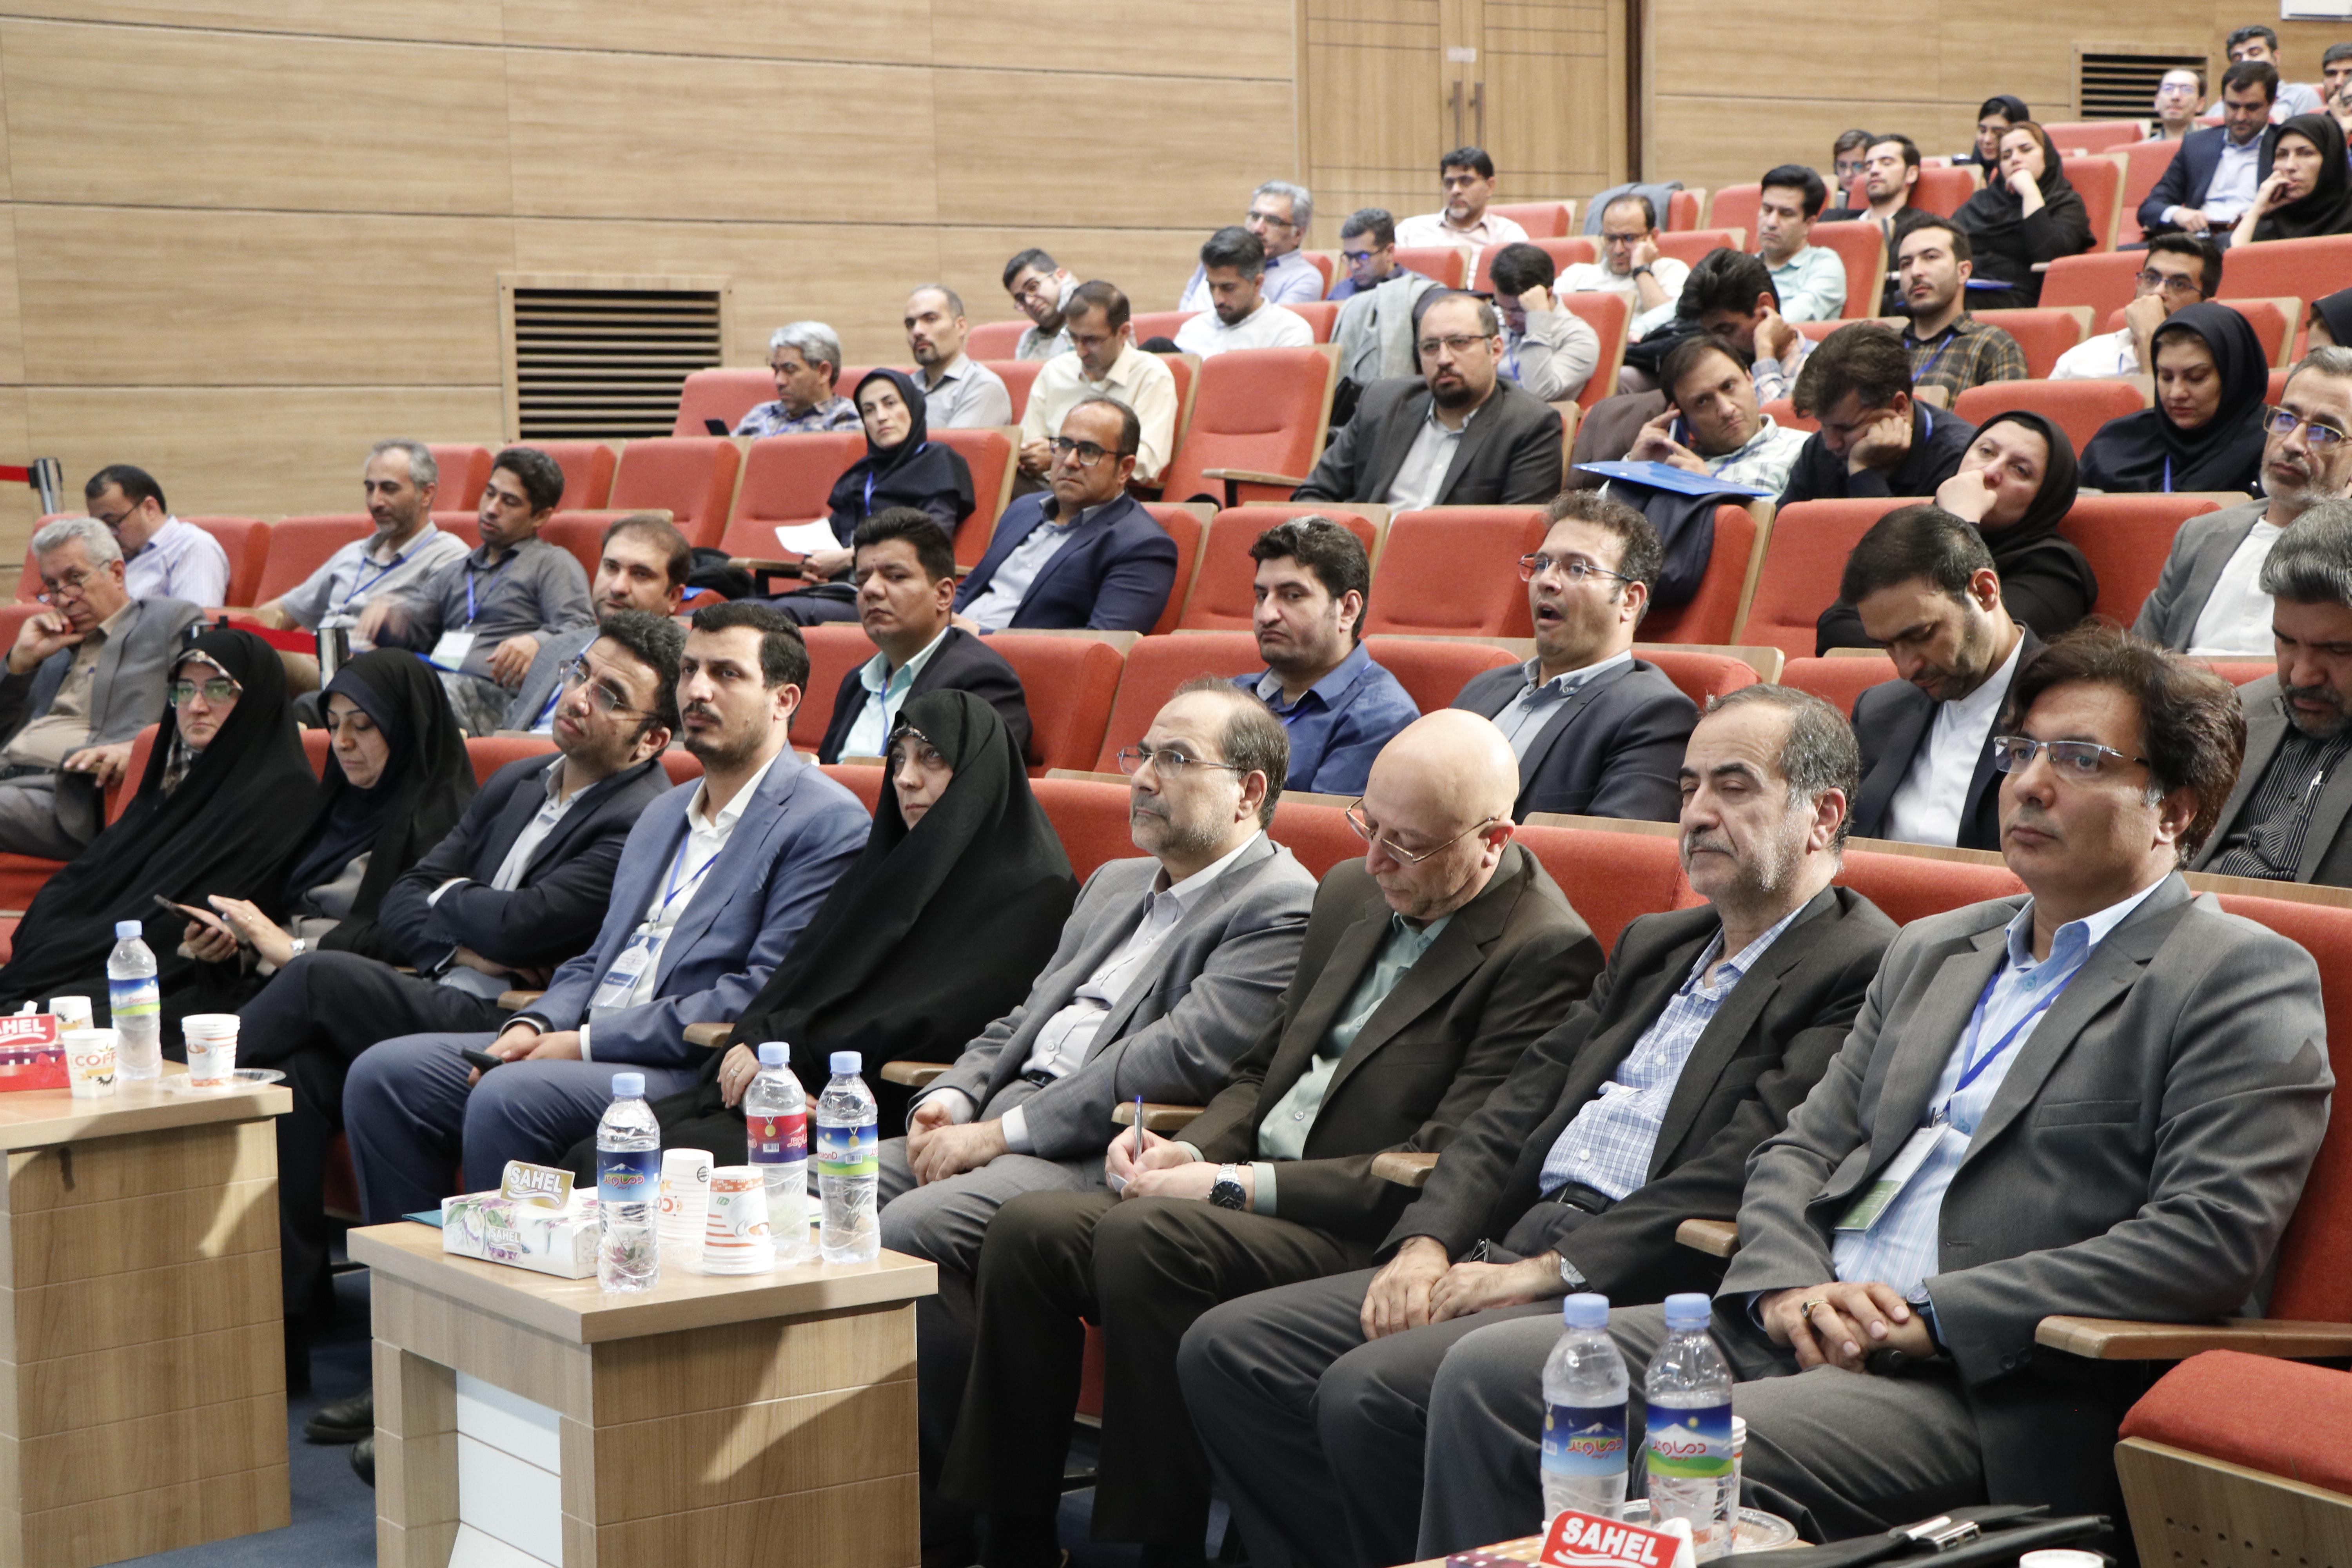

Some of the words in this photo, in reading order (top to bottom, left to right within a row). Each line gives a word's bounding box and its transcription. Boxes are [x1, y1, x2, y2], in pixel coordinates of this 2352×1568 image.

[0, 1018, 46, 1034] HEL
[510, 1166, 563, 1194] SAHEL
[604, 1174, 645, 1187] دماوند
[489, 1227, 520, 1243] SAHEL
[1566, 1437, 1623, 1455] دماوند
[1652, 1440, 1707, 1455] دماوند
[1561, 1517, 1659, 1566] SAHEL
